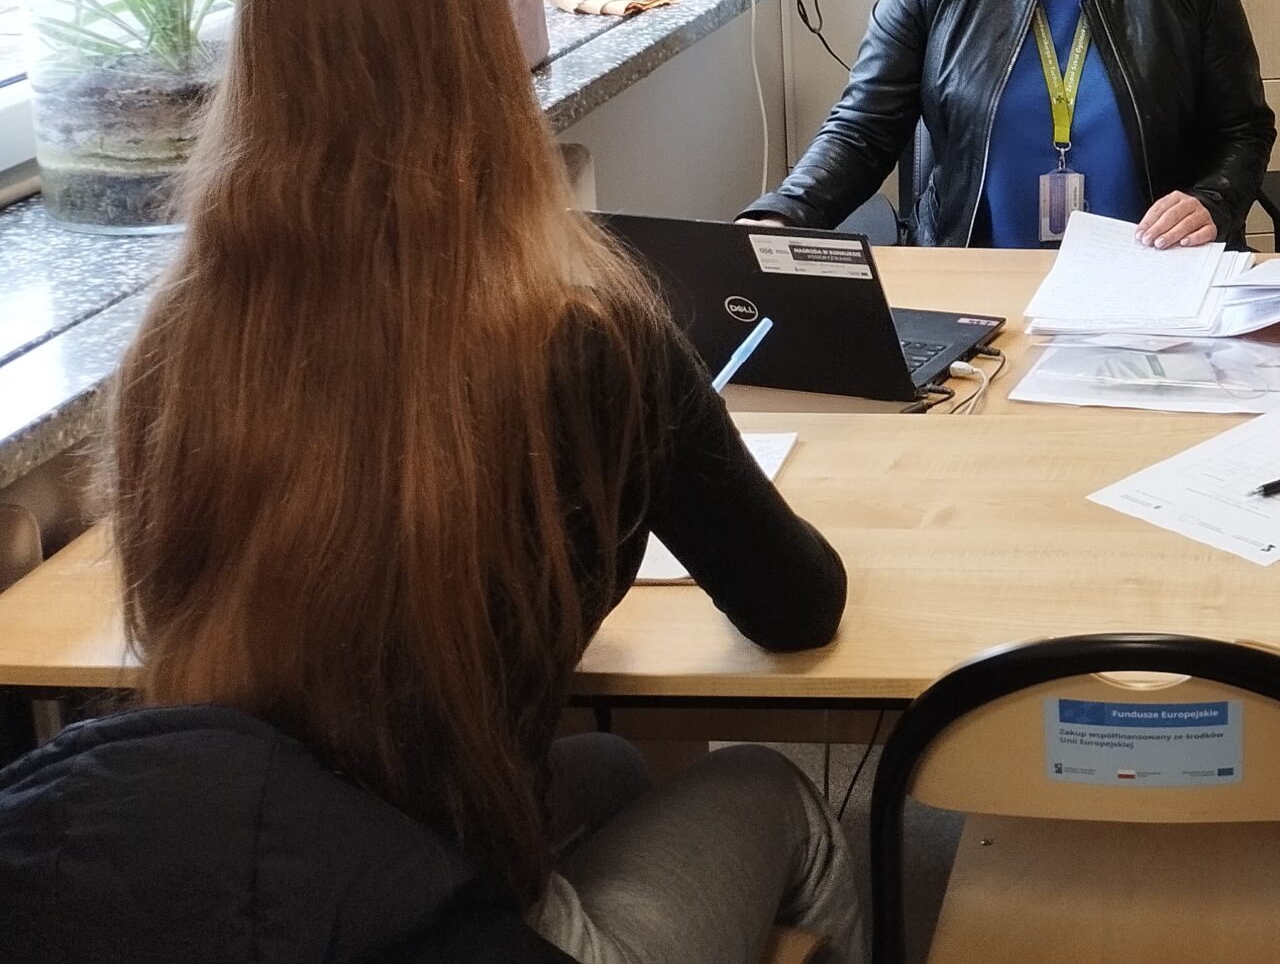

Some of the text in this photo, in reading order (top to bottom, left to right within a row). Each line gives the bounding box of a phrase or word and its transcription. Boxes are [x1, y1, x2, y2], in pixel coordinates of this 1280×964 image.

[729, 304, 756, 314] DELL
[1112, 709, 1219, 720] Fundusze Europejskie
[1059, 728, 1087, 738] Zakup
[1089, 731, 1171, 742] współfinansowany
[1186, 731, 1224, 740] środków
[1060, 737, 1134, 749] Unii Europejskiej
